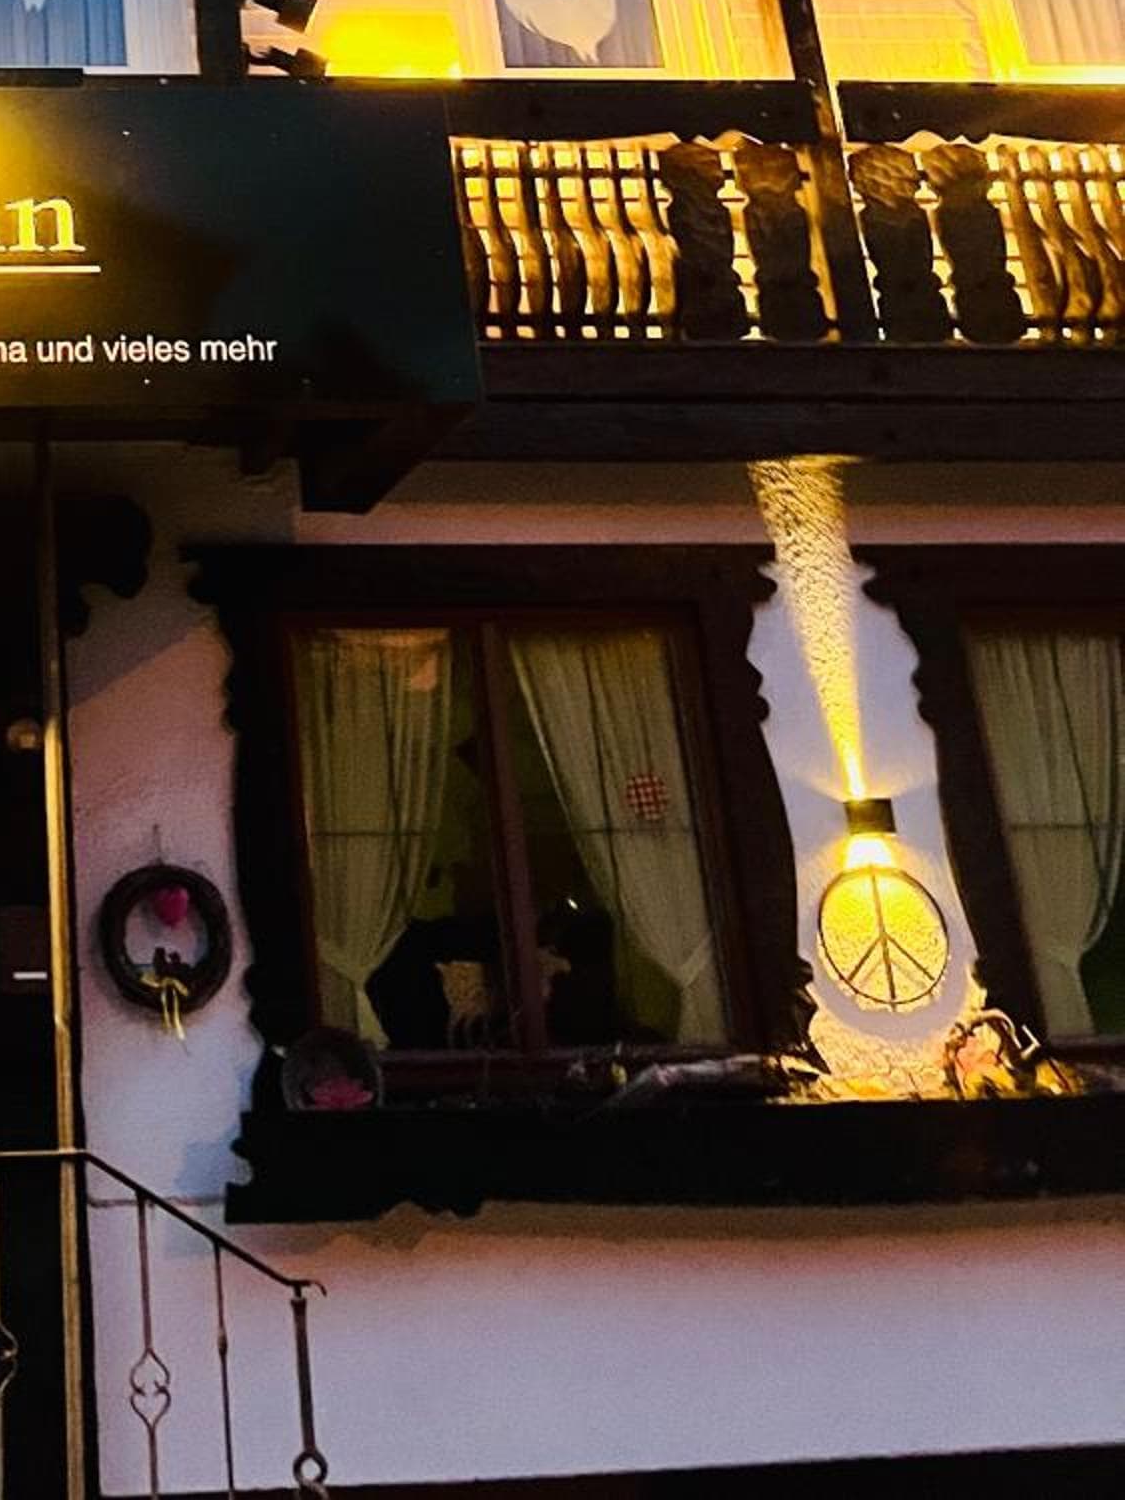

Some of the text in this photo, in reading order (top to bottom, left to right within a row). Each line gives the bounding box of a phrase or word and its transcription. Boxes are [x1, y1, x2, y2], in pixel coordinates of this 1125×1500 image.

[36, 335, 93, 362] und
[102, 334, 190, 362] vieles
[200, 334, 277, 361] mehr
